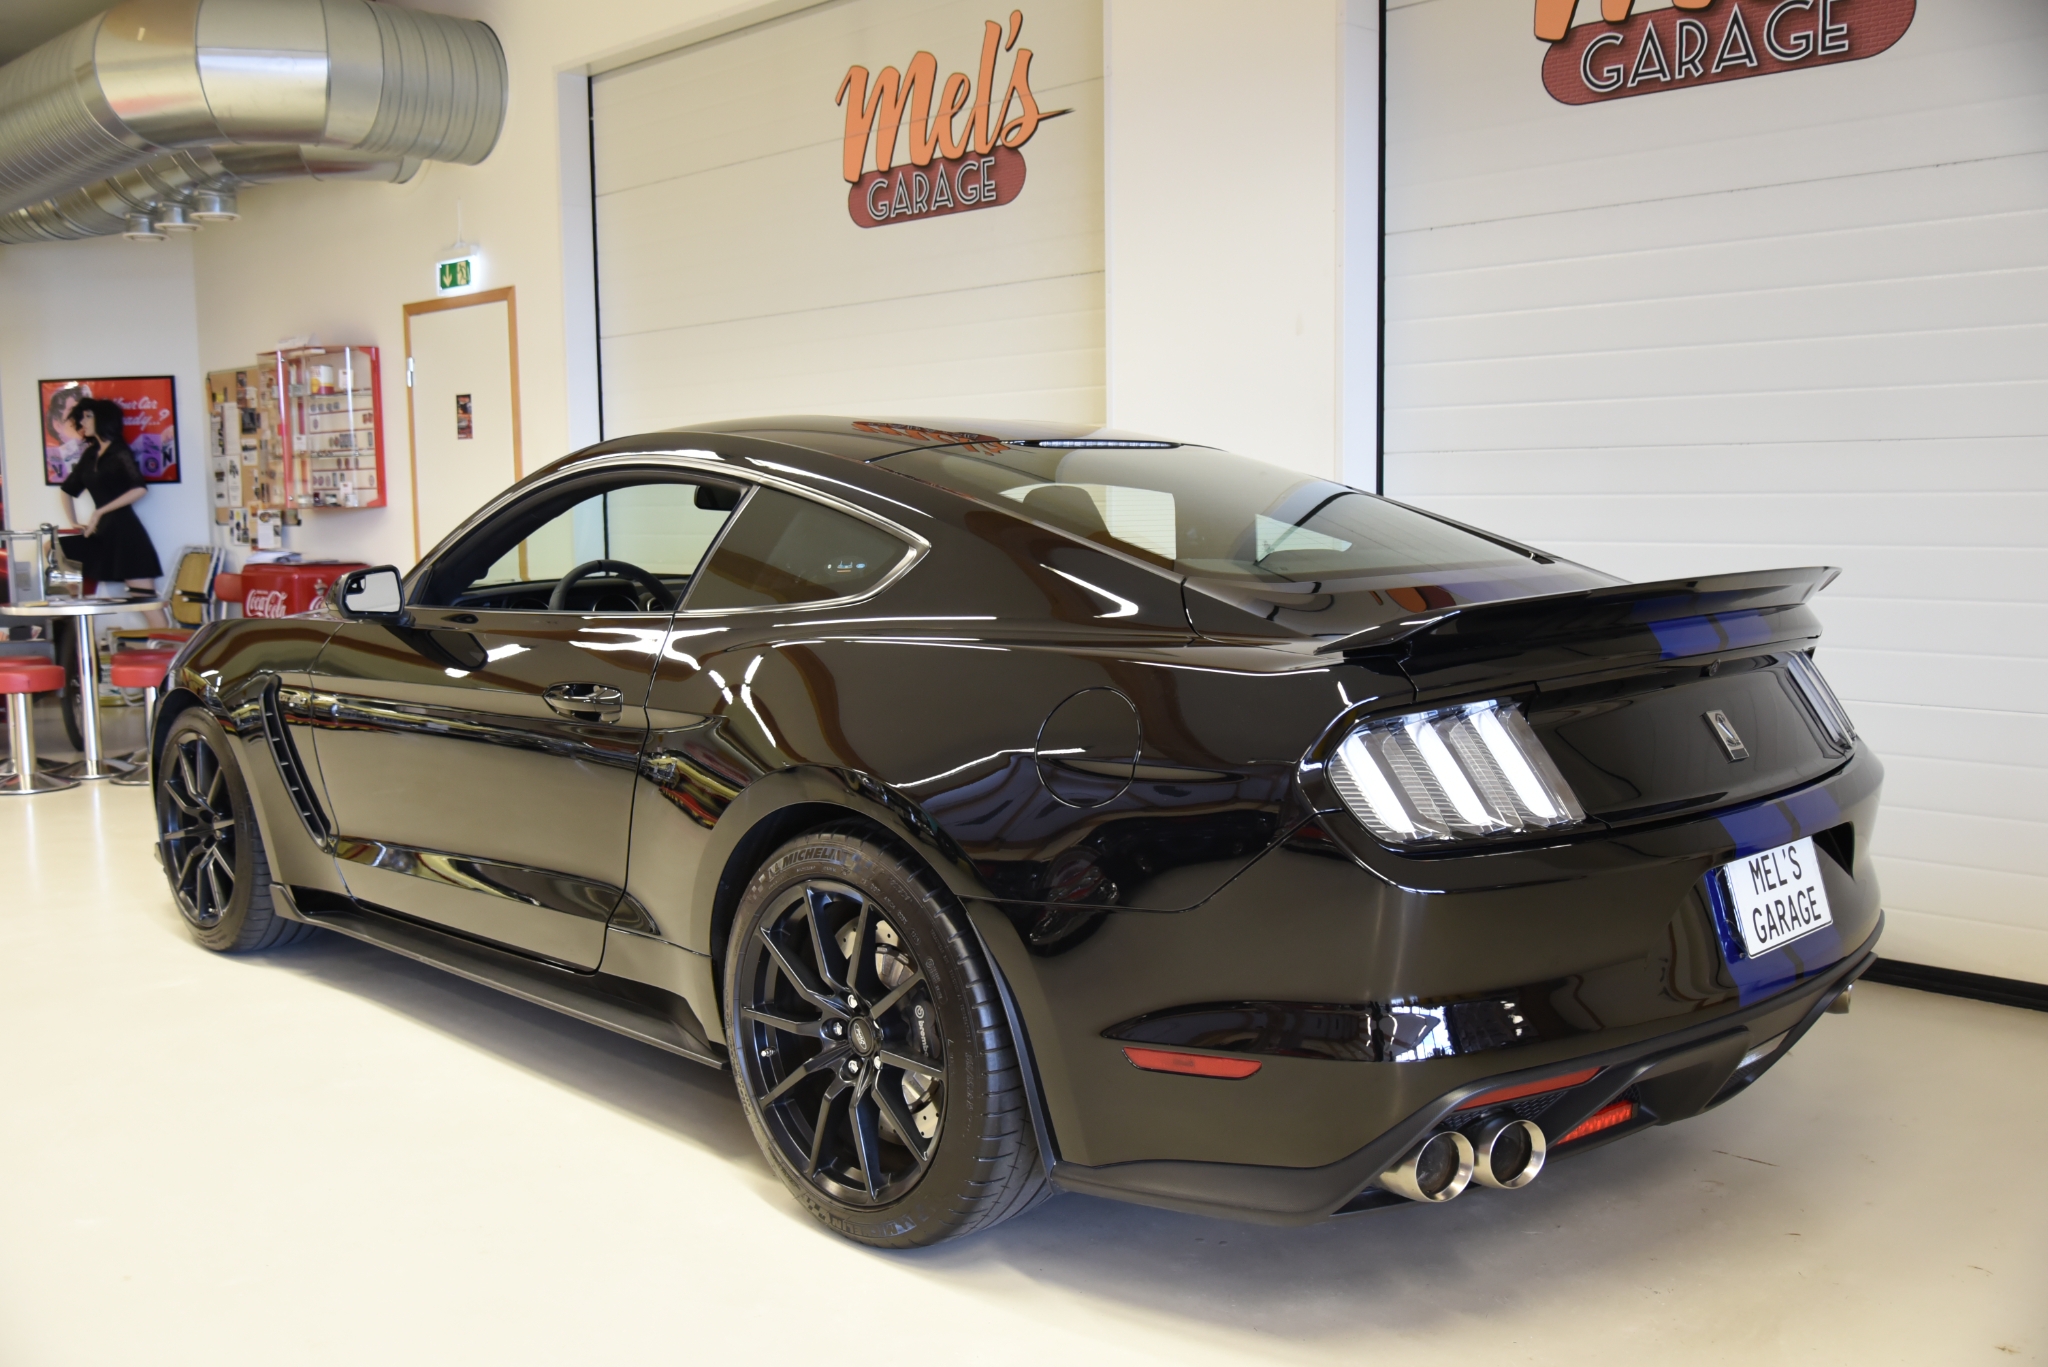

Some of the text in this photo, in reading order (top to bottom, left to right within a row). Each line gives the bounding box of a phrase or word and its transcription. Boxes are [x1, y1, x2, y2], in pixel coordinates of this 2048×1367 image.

[1580, 0, 1849, 93] GARAGE
[867, 157, 997, 221] GARAGE
[782, 847, 842, 869] MICHELIN
[1748, 845, 1802, 896] MEL'S
[1752, 886, 1822, 944] GARAGE
